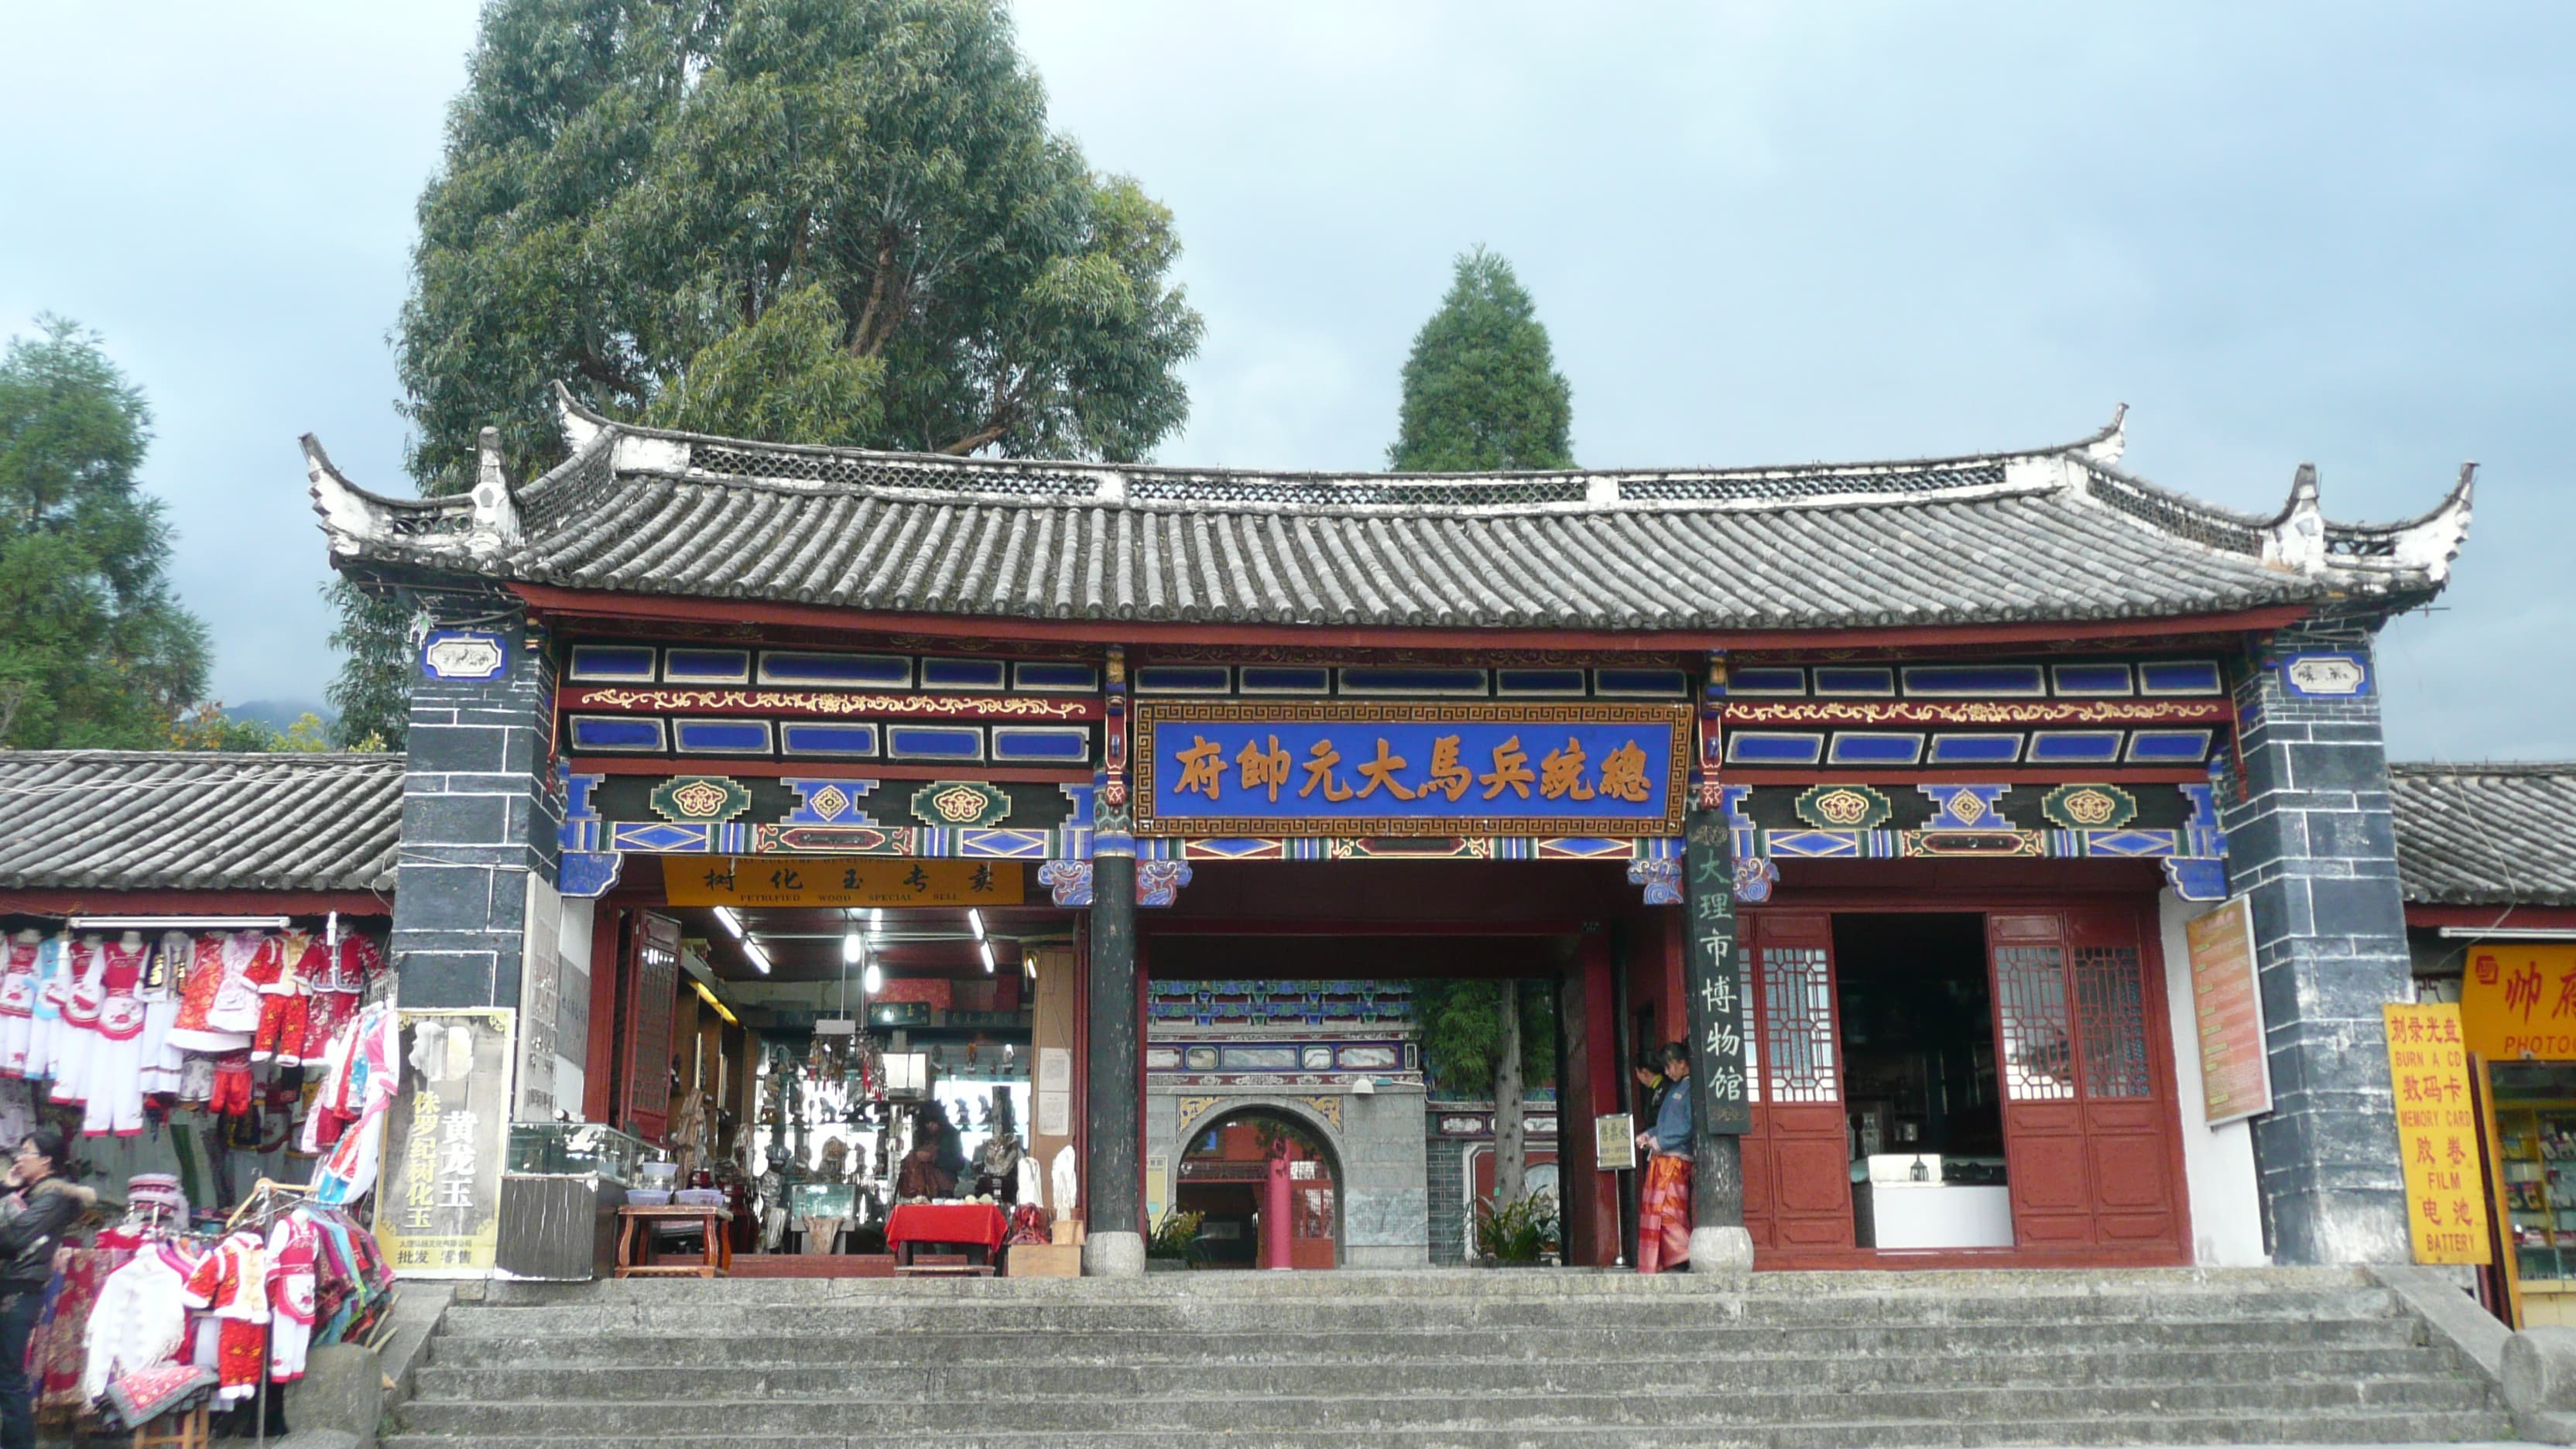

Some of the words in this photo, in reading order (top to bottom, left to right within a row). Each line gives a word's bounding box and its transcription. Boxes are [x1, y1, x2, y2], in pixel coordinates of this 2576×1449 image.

[704, 864, 994, 892] 树化玉专卖
[818, 893, 851, 902] WOOD
[1694, 849, 1744, 1101] 大理市博物馆
[2391, 1015, 2461, 1044] 刻录光盘
[2504, 1034, 2576, 1054] PHOTO
[2395, 1051, 2424, 1067] BURN
[2433, 1051, 2440, 1067] A
[2447, 1051, 2462, 1067] CD
[2403, 1074, 2462, 1103] 数码卡
[2401, 1110, 2439, 1128] MEMORY
[2446, 1110, 2472, 1128] CARD
[404, 1091, 441, 1229] 侏罗纪树化玉
[437, 1110, 479, 1208] 黄龙玉
[2417, 1136, 2466, 1165] 胶卷
[2427, 1172, 2461, 1190] FILM
[2422, 1197, 2473, 1226] 电池
[2427, 1233, 2475, 1252] BATTERY
[397, 1250, 430, 1264] 批发
